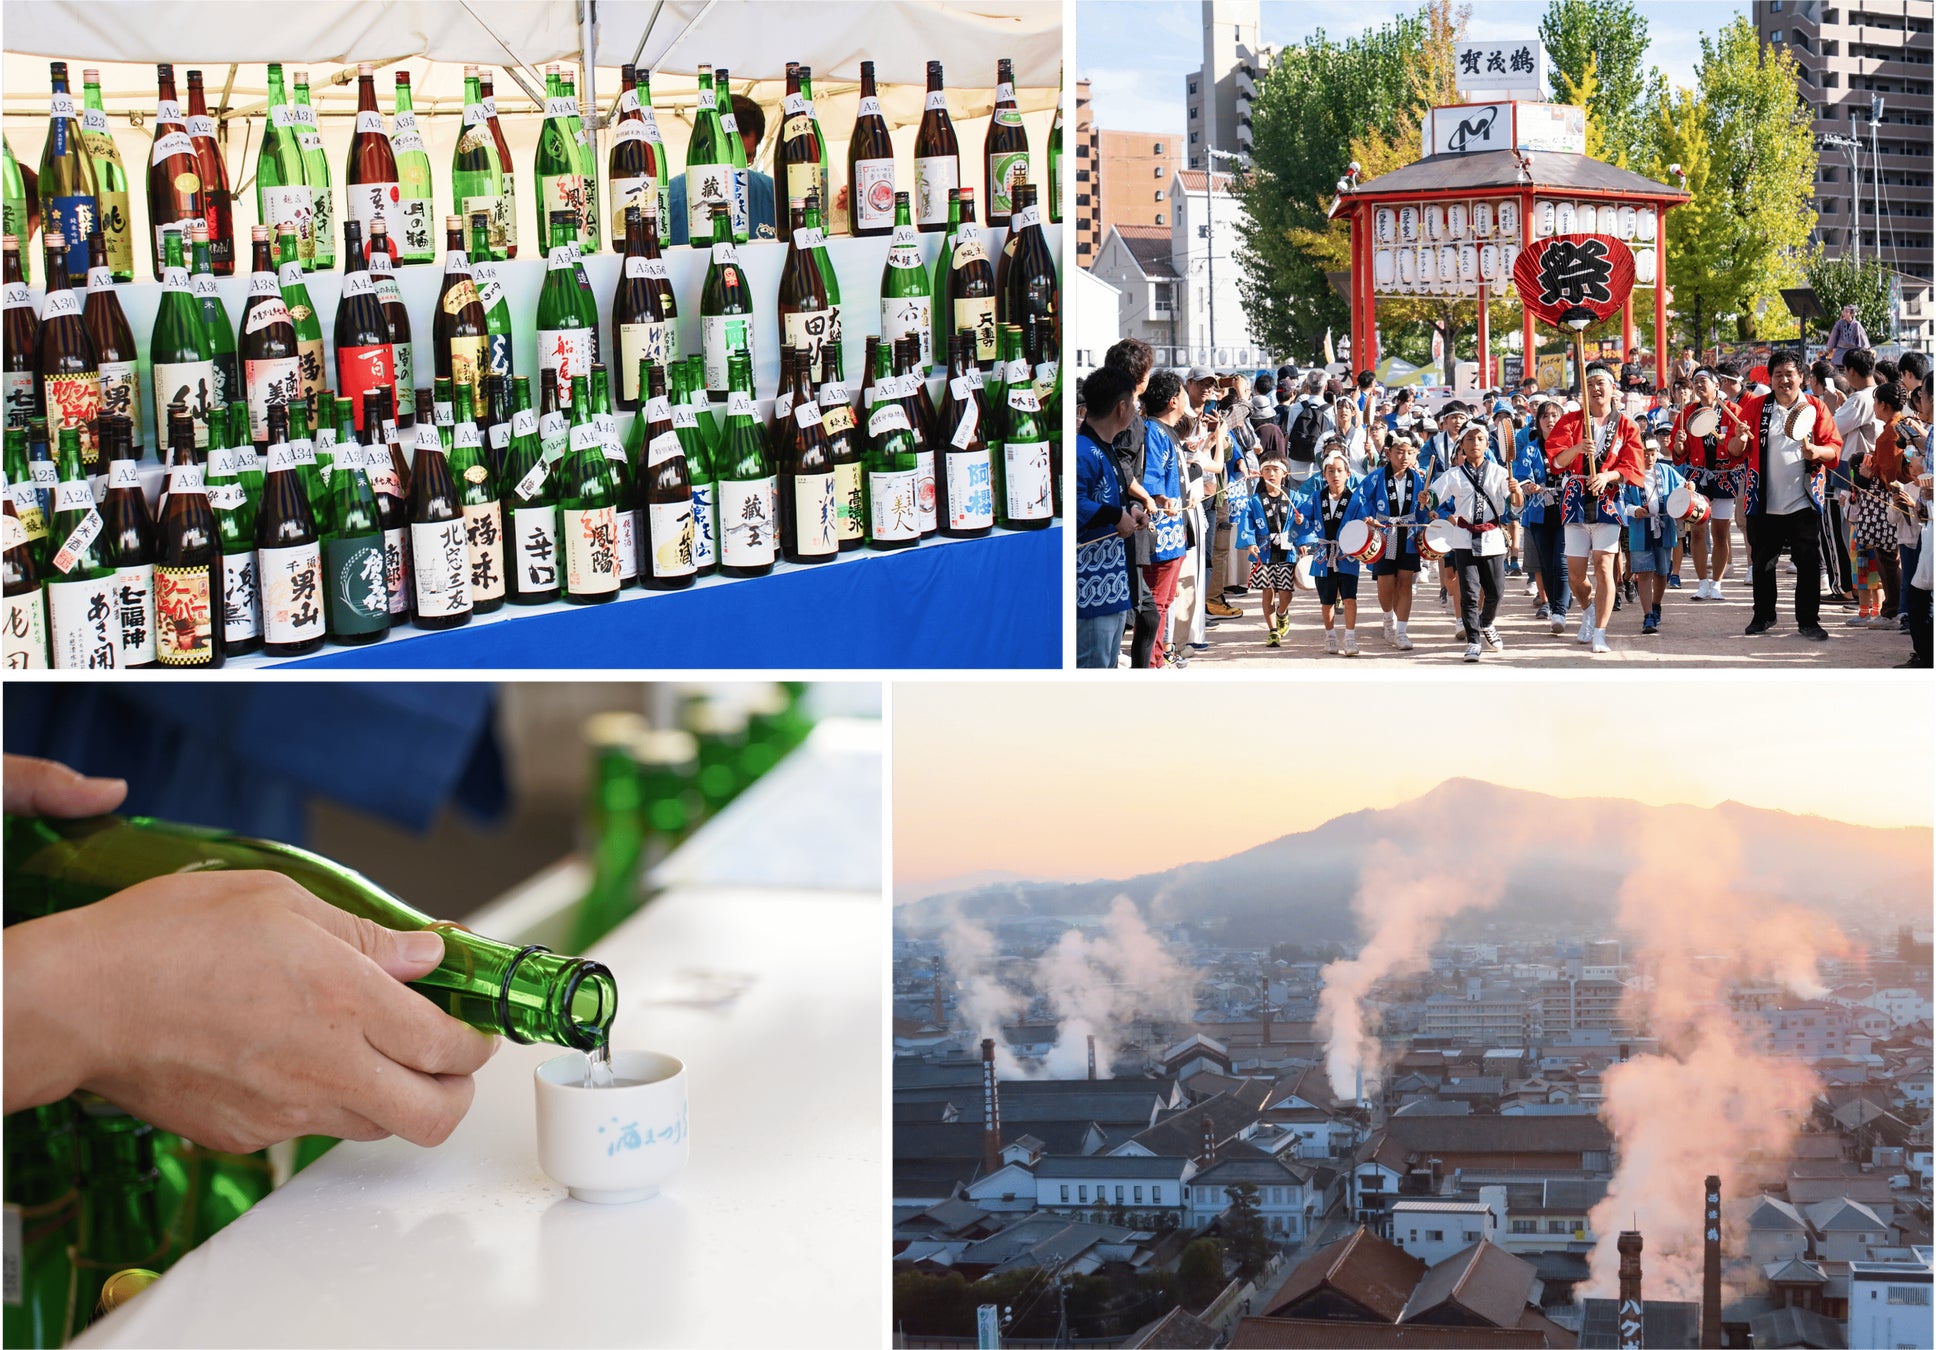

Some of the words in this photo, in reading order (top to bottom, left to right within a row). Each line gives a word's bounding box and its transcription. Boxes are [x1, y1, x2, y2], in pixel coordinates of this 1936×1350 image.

[1460, 46, 1535, 75] 賀茂鶴
[51, 101, 73, 113] A25
[84, 115, 105, 128] A23
[394, 112, 415, 128] A35
[403, 202, 431, 248] 月の輪
[370, 259, 391, 270] A44
[1537, 238, 1613, 306] 祭
[476, 268, 496, 280] A48
[251, 279, 276, 291] A38
[49, 297, 76, 312] A30
[104, 384, 131, 413] 男
[265, 379, 287, 404] 美
[1761, 403, 1773, 448] 酒まつり
[366, 453, 390, 465] A38
[30, 469, 56, 482] A25
[63, 489, 92, 505] A26
[66, 512, 99, 553] 純米酒
[290, 569, 320, 629] 男山
[119, 585, 147, 651] 七福神
